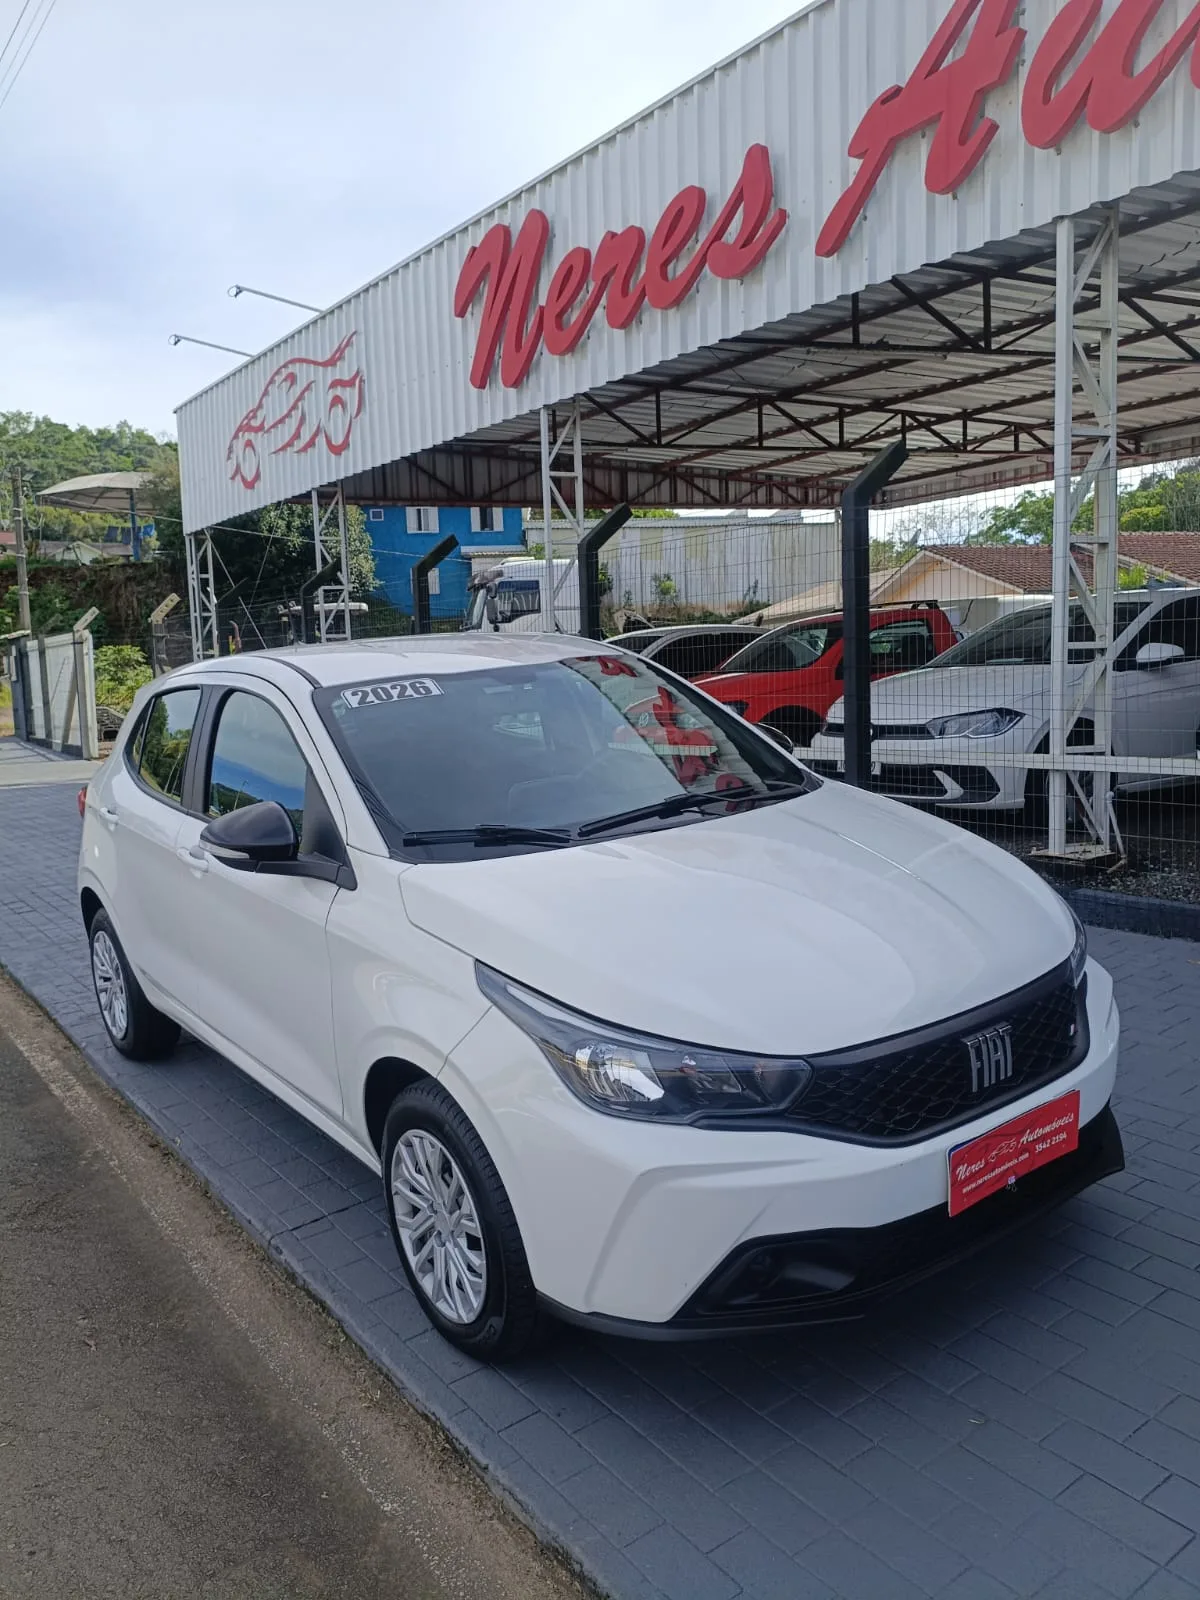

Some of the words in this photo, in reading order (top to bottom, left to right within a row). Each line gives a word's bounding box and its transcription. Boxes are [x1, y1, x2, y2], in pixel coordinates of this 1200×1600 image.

[454, 143, 787, 389] Neres
[814, 0, 1200, 258] Au
[351, 680, 433, 706] 2026
[965, 1024, 1013, 1093] FIAT
[956, 1157, 986, 1182] Neres
[1019, 1112, 1075, 1148] Automóveis
